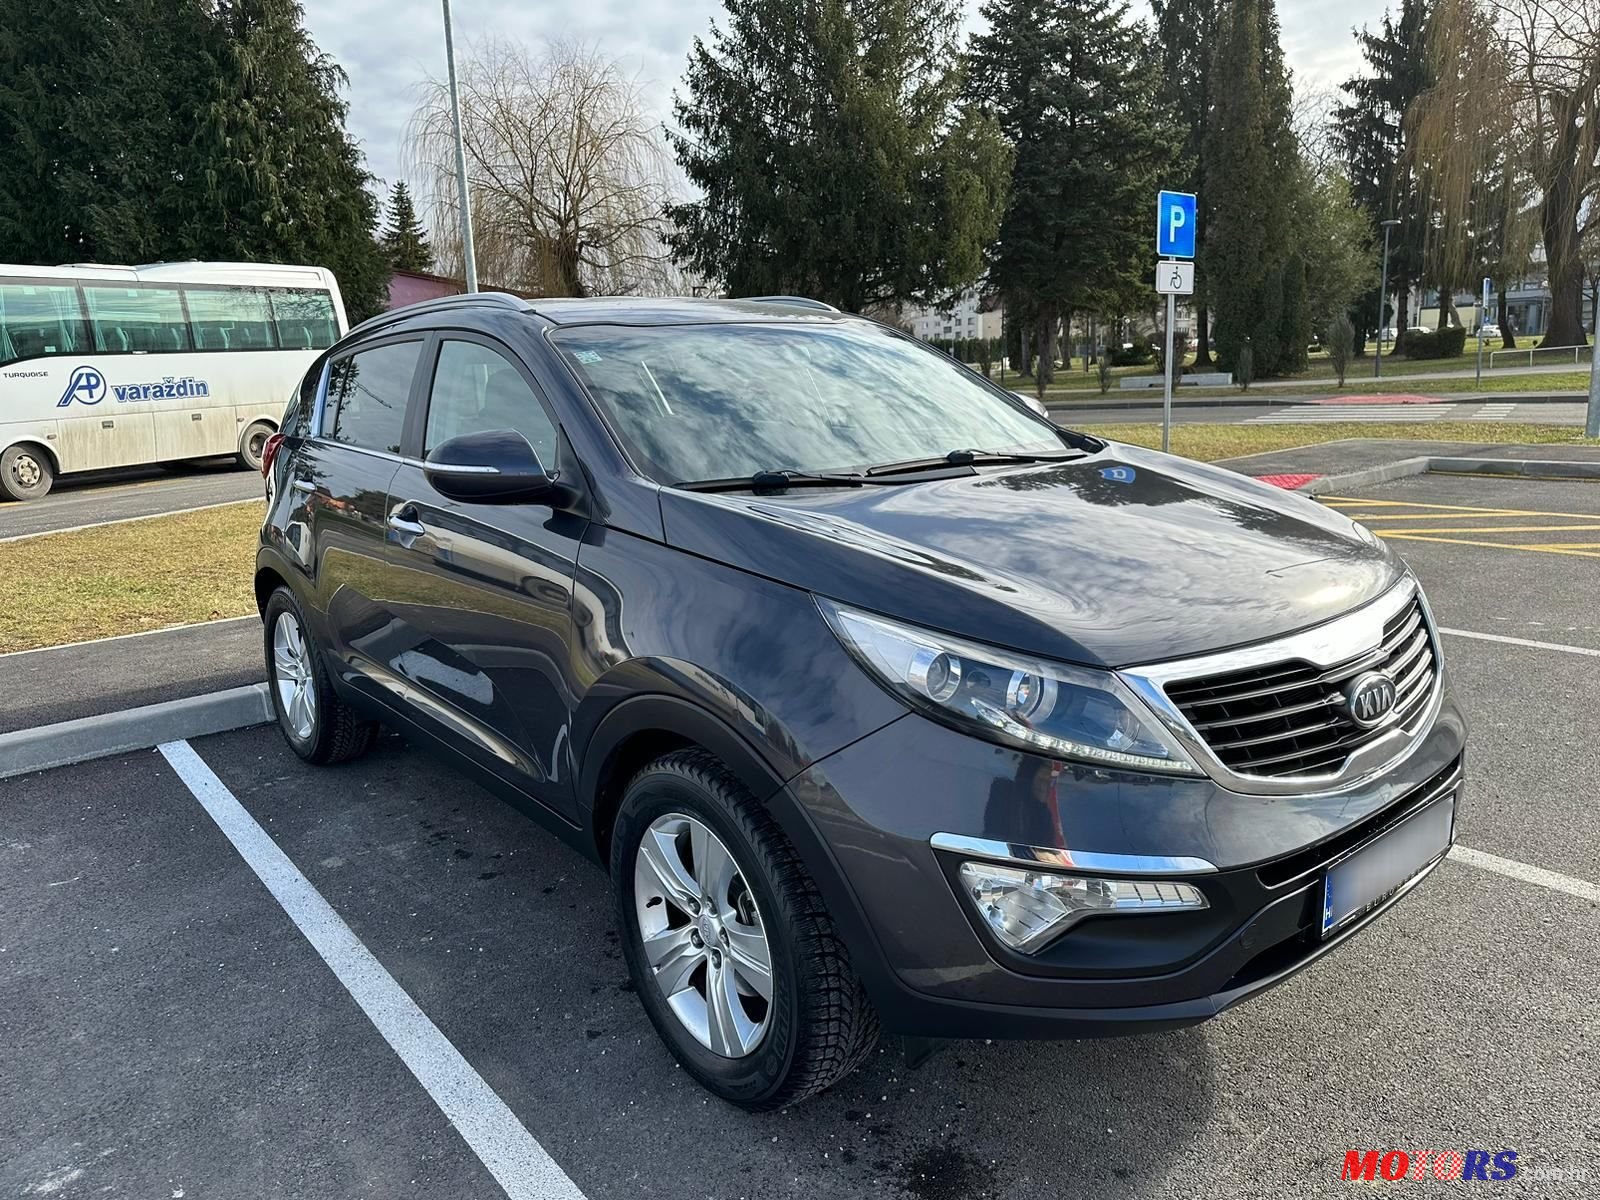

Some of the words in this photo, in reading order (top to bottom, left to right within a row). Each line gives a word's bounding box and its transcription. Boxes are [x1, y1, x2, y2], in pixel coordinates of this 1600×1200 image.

[1169, 205, 1185, 243] P
[114, 377, 208, 403] varaždin
[1359, 684, 1392, 719] KIA
